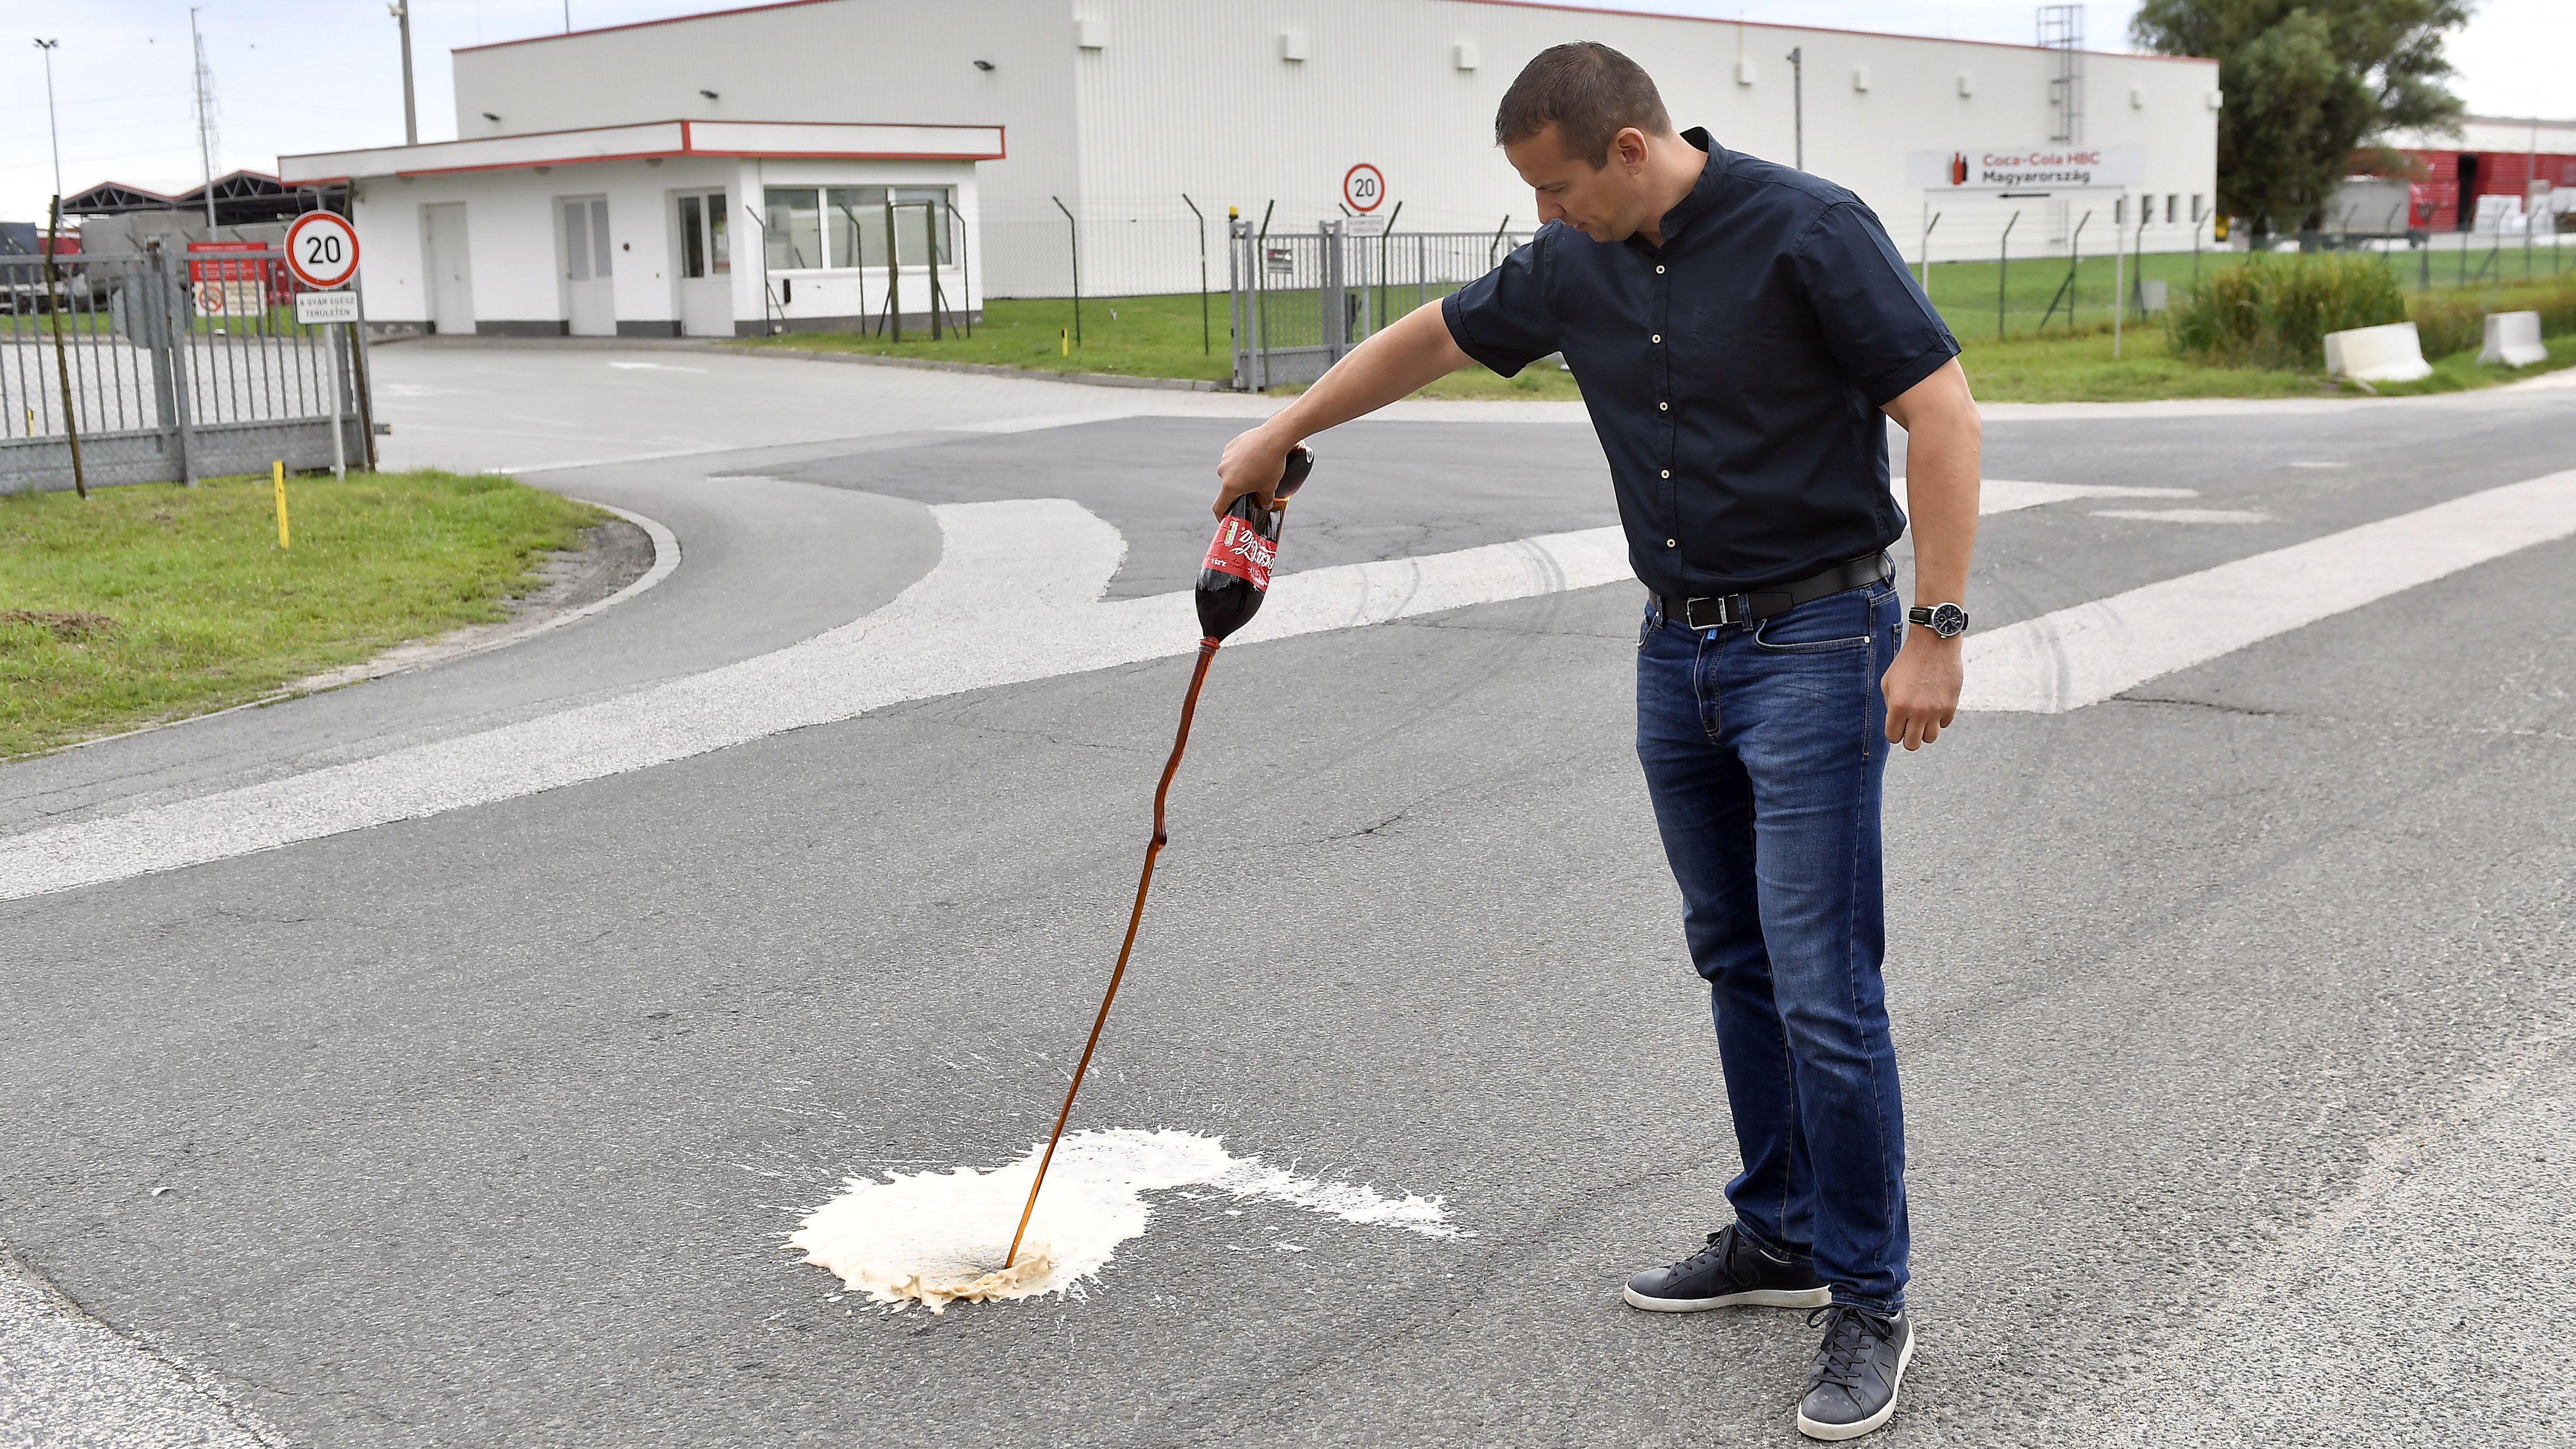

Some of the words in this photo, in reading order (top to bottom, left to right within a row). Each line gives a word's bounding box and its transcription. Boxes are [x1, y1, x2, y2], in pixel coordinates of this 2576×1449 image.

[1983, 152, 2063, 167] Coca-Cola
[2067, 151, 2100, 165] HBC
[1983, 169, 2091, 185] Magyarország
[1356, 179, 1374, 197] 20
[306, 236, 341, 263] 20
